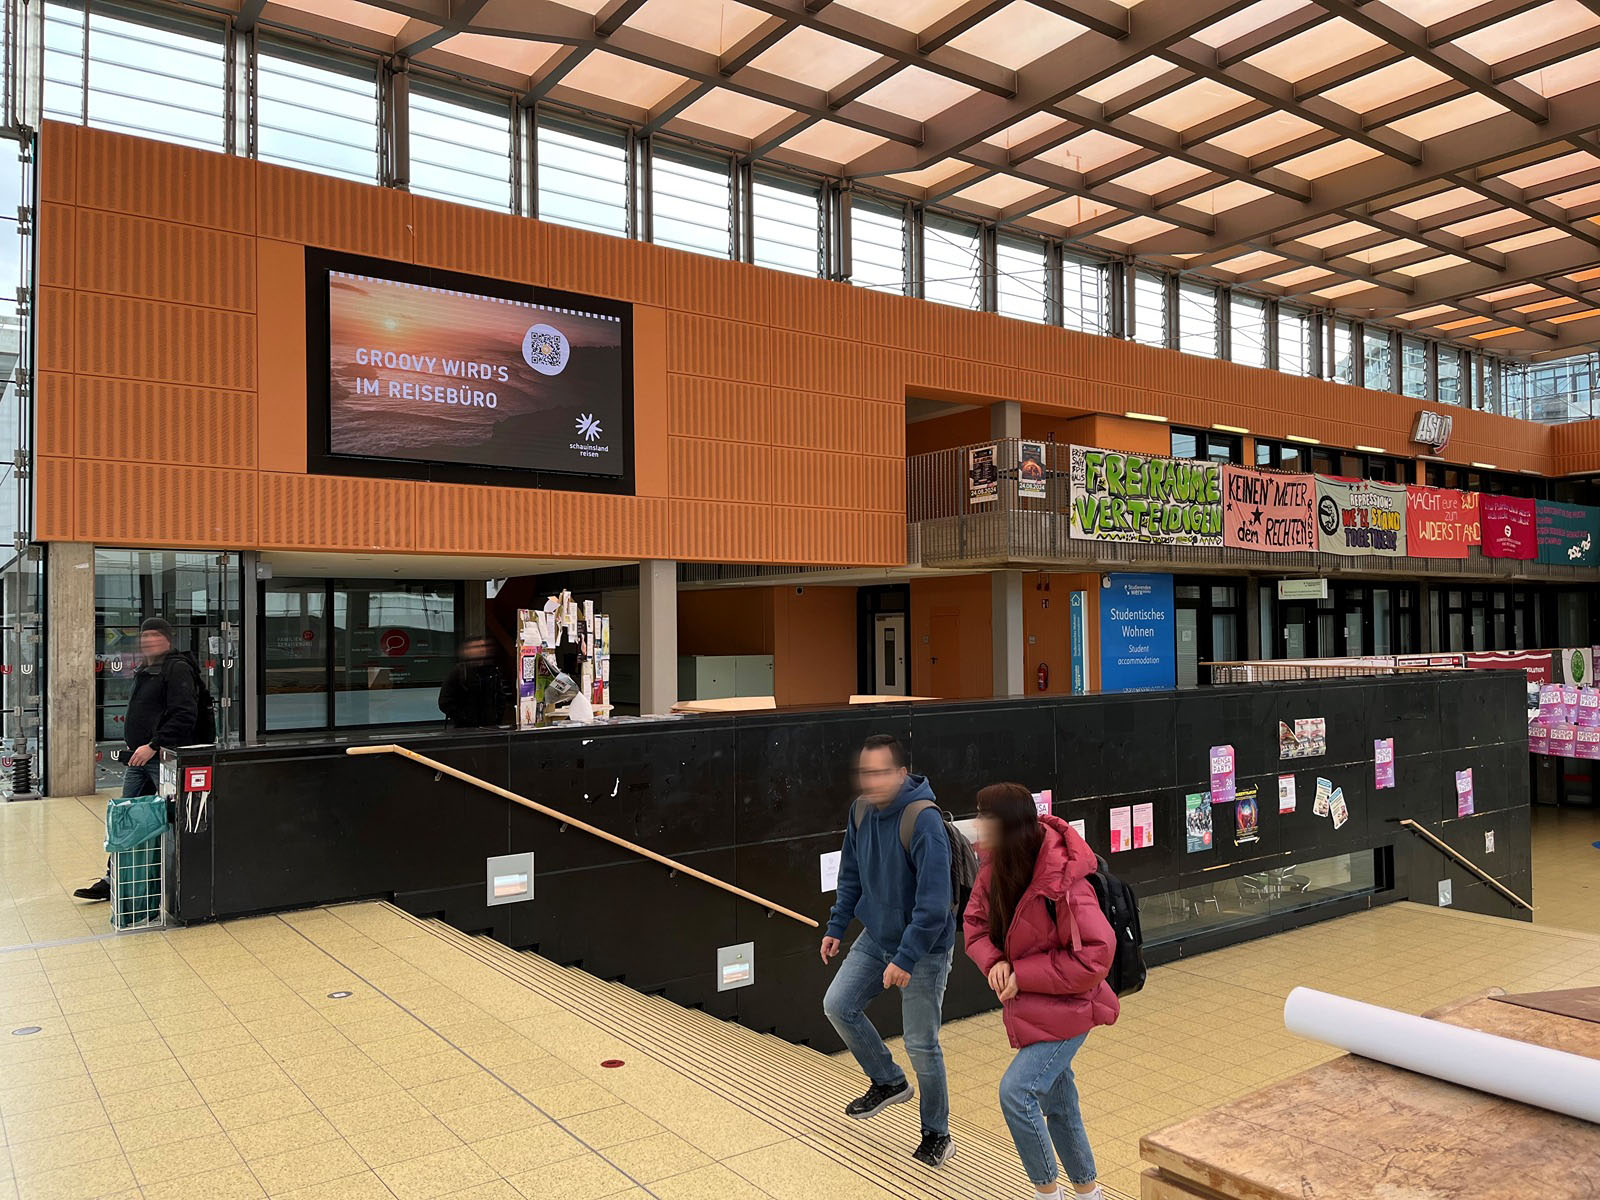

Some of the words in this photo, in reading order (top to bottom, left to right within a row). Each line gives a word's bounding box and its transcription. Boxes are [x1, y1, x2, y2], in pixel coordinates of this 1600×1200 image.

[355, 348, 437, 374] GROOVY
[442, 358, 509, 383] WIRD'S
[356, 377, 379, 396] IM
[389, 381, 498, 409] REISEBÜRO
[569, 443, 609, 452] schauinsland
[1229, 473, 1268, 506] KEINEN
[1273, 482, 1307, 507] METER
[1406, 492, 1441, 511] MACHT
[1076, 495, 1224, 538] VERTEIDIGEN
[1371, 507, 1400, 531] STAND
[1237, 521, 1259, 544] dem
[1265, 518, 1307, 547] RECHTEN
[1110, 608, 1165, 621] Studentisches
[1122, 625, 1154, 638] Wohnen
[1129, 644, 1150, 653] Student
[1118, 657, 1160, 666] accommodation
[1212, 757, 1232, 765] MENSA
[1213, 764, 1232, 773] PARTY
